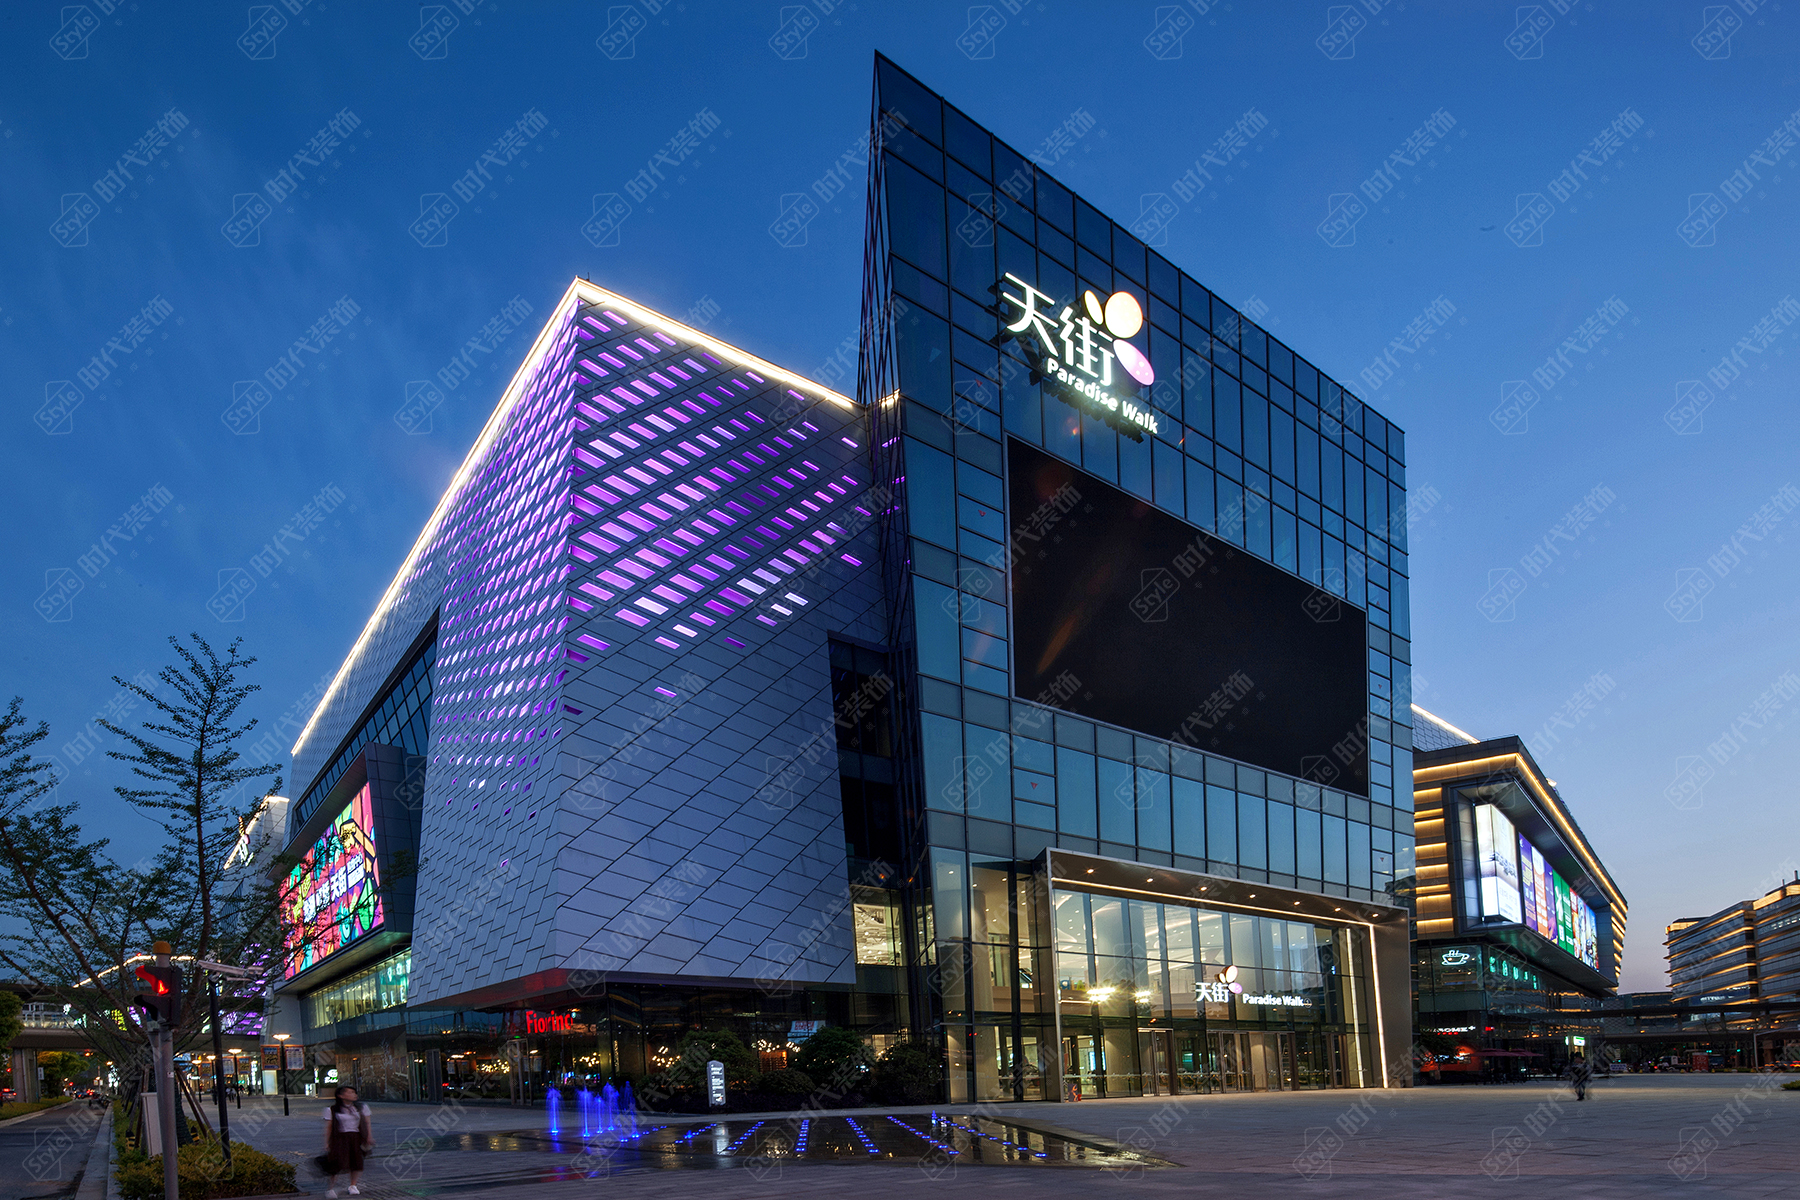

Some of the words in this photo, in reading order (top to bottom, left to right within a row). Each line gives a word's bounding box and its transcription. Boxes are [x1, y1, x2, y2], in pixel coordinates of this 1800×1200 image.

[1002, 271, 1115, 387] 天街
[1047, 357, 1119, 411] Paradise
[1121, 400, 1159, 434] Walk
[1195, 981, 1230, 1003] 天街
[1242, 993, 1282, 1006] Paradise
[1282, 995, 1304, 1007] Walk
